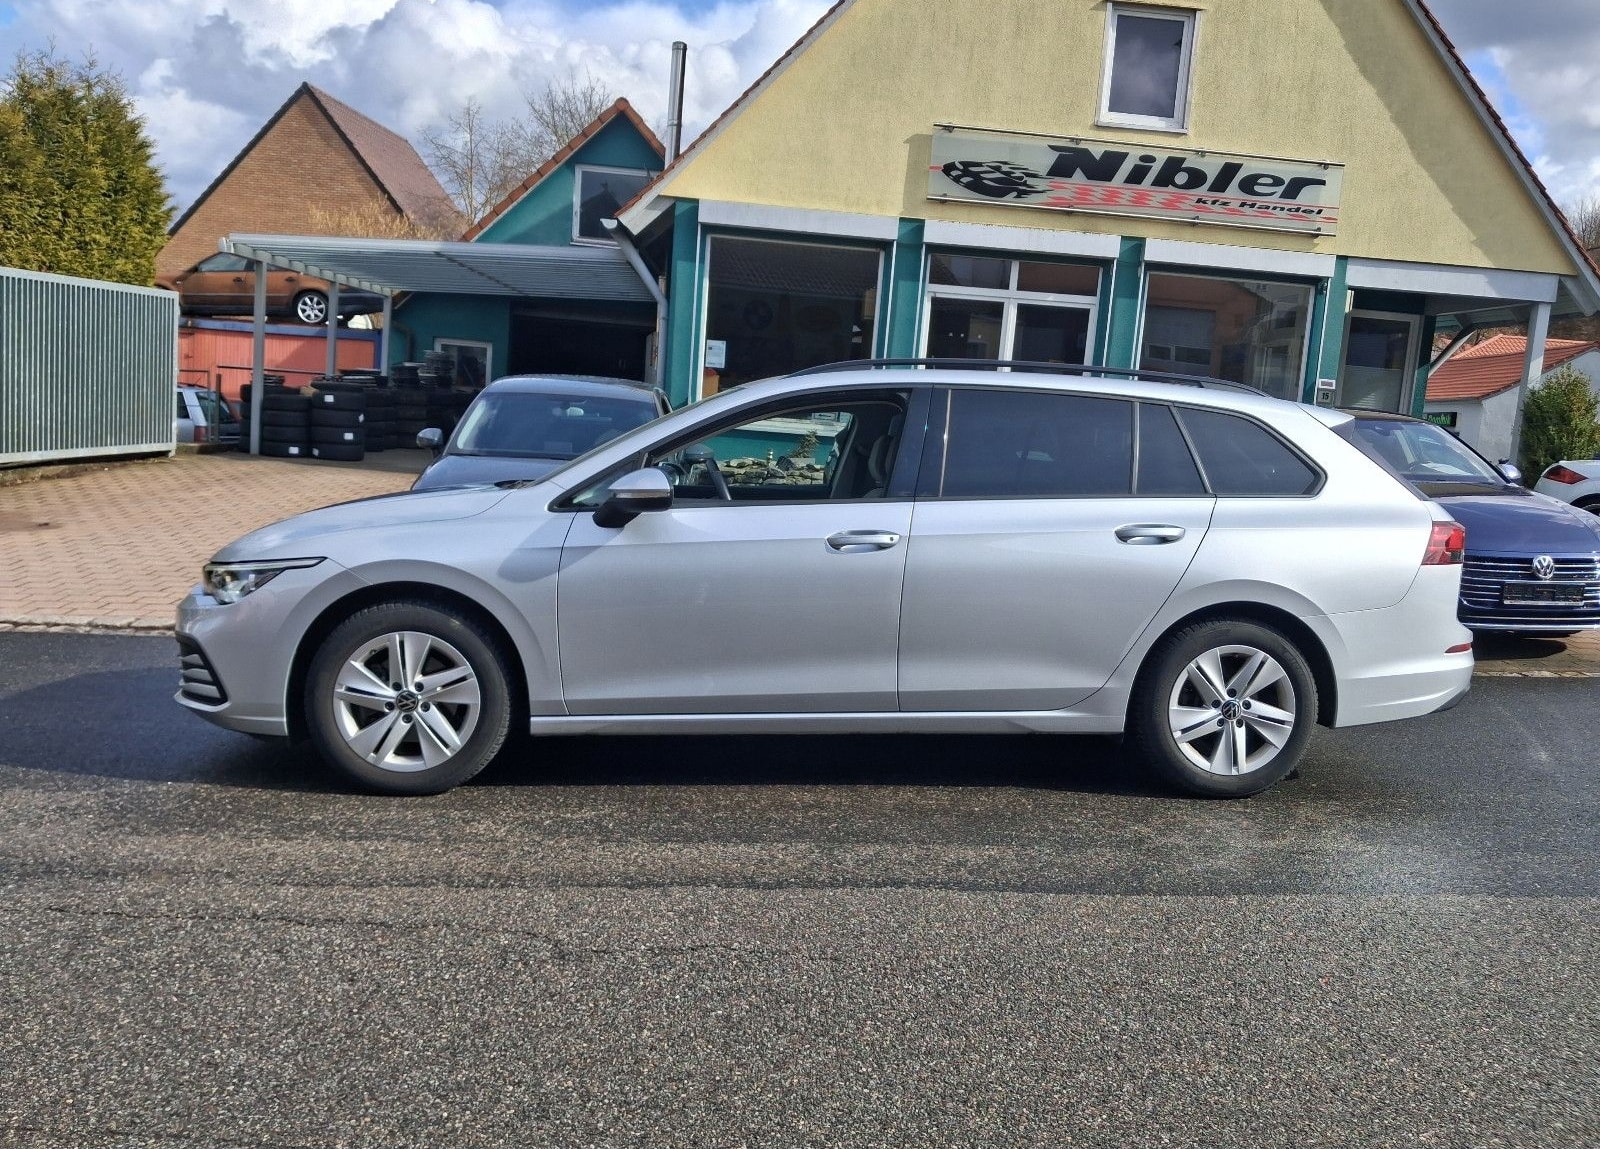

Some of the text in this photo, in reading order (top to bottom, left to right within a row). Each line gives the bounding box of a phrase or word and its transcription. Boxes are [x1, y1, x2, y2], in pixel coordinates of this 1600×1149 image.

[1046, 144, 1326, 200] Nibler
[1239, 201, 1324, 215] Handel
[1321, 392, 1330, 400] 15
